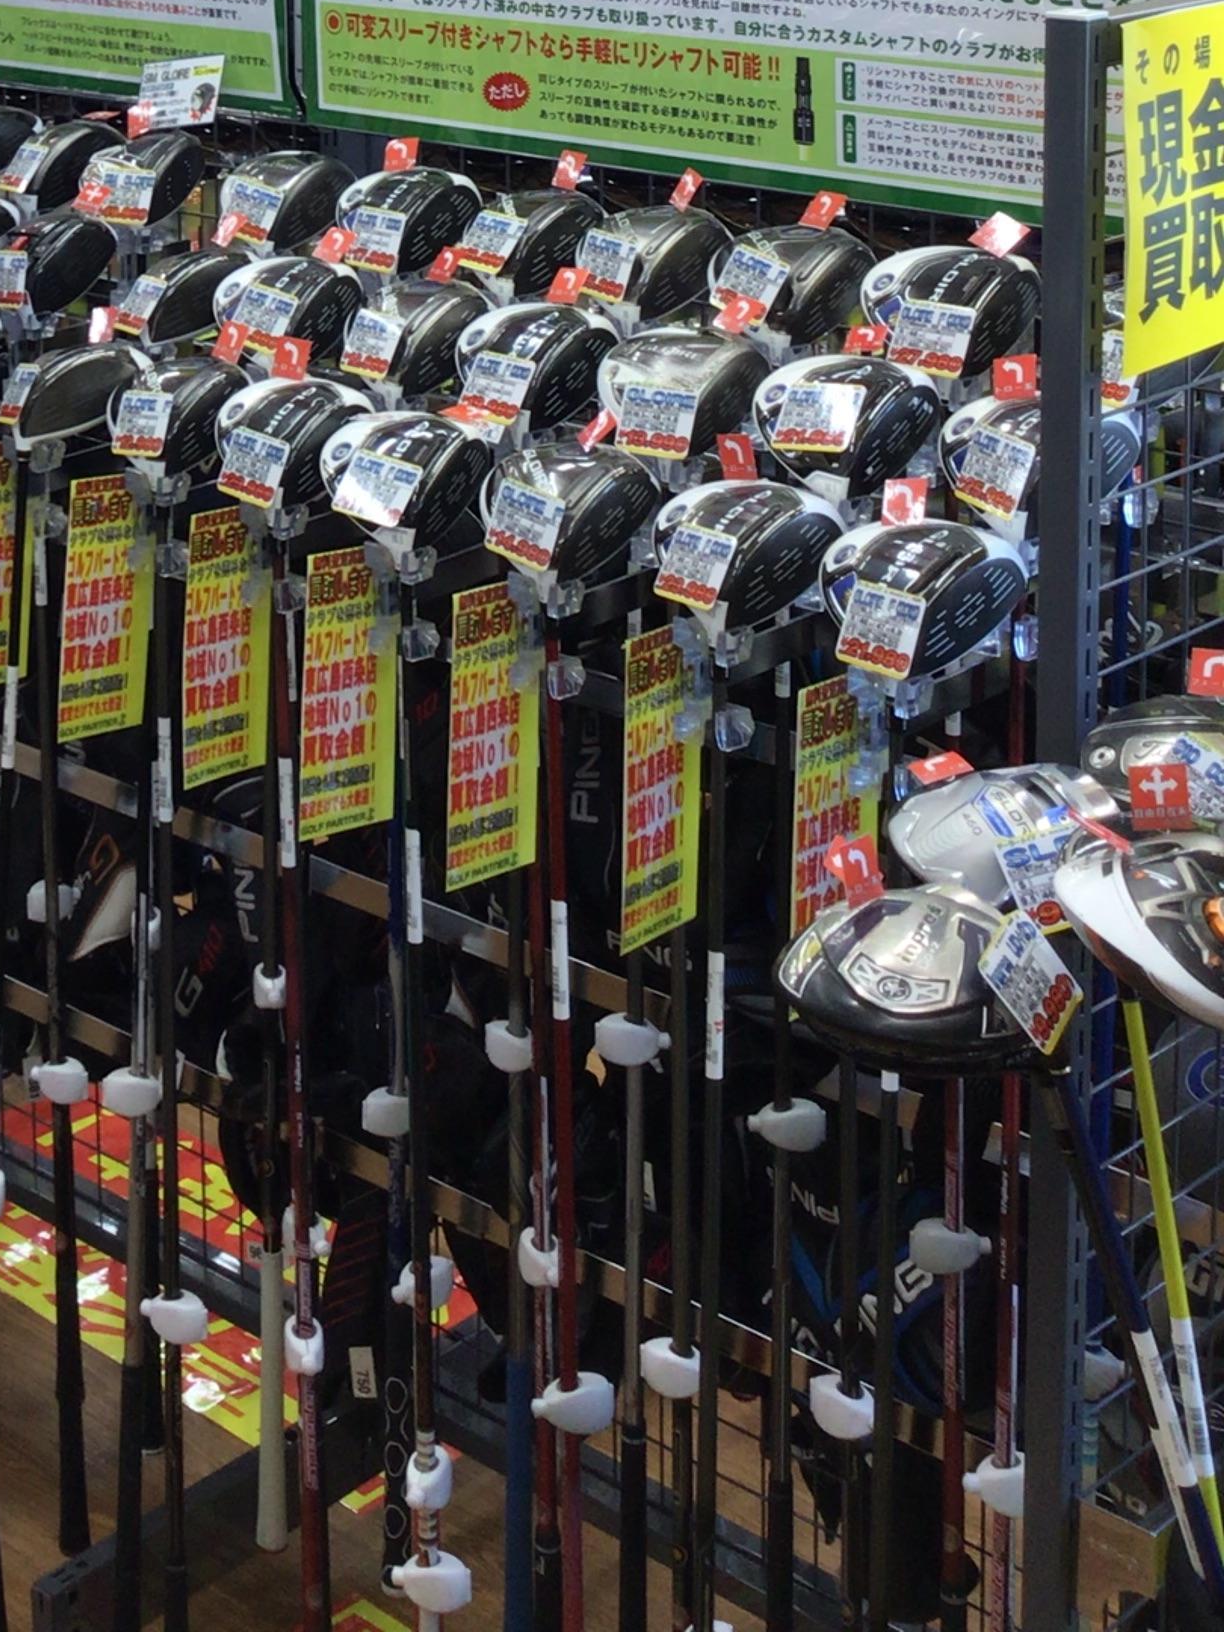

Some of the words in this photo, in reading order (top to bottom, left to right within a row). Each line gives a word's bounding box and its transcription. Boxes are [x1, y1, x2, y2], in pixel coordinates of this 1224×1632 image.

[1135, 35, 1210, 84] その場
[487, 82, 526, 102] ただし
[234, 862, 258, 943] PIN
